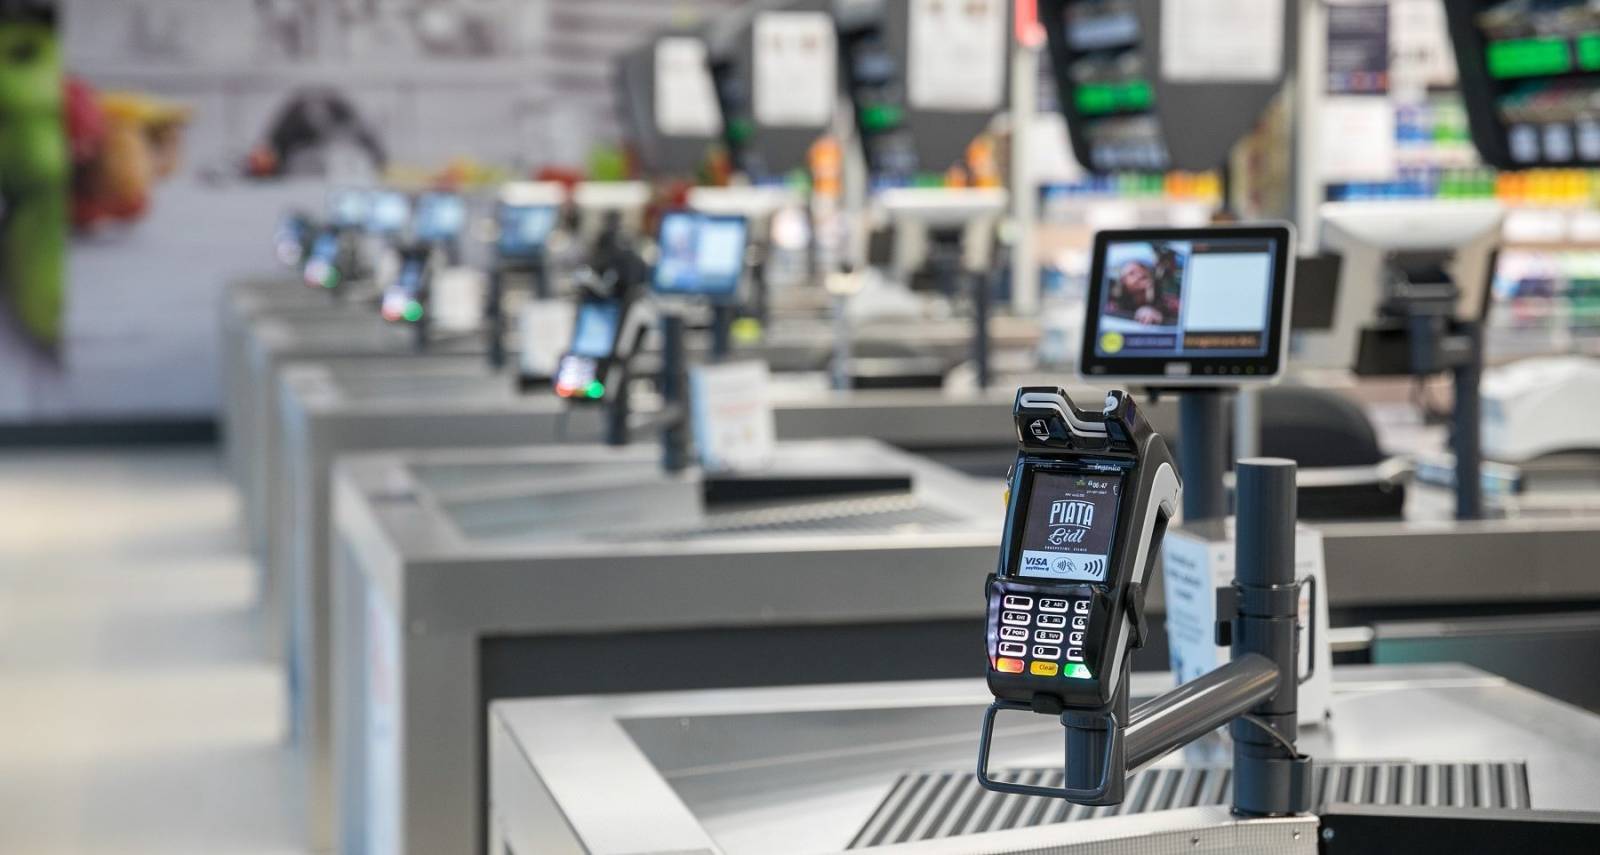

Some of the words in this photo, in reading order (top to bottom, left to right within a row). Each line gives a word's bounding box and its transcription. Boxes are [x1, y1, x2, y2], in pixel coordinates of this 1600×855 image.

[1048, 528, 1085, 545] Lidl
[1025, 557, 1048, 566] VISA
[1044, 600, 1050, 608] 2
[1081, 602, 1087, 610] 3
[1007, 612, 1013, 620] 4
[1077, 618, 1084, 626] 6
[1040, 631, 1046, 639] 8
[1075, 633, 1082, 641] 9
[1037, 647, 1044, 655] 0
